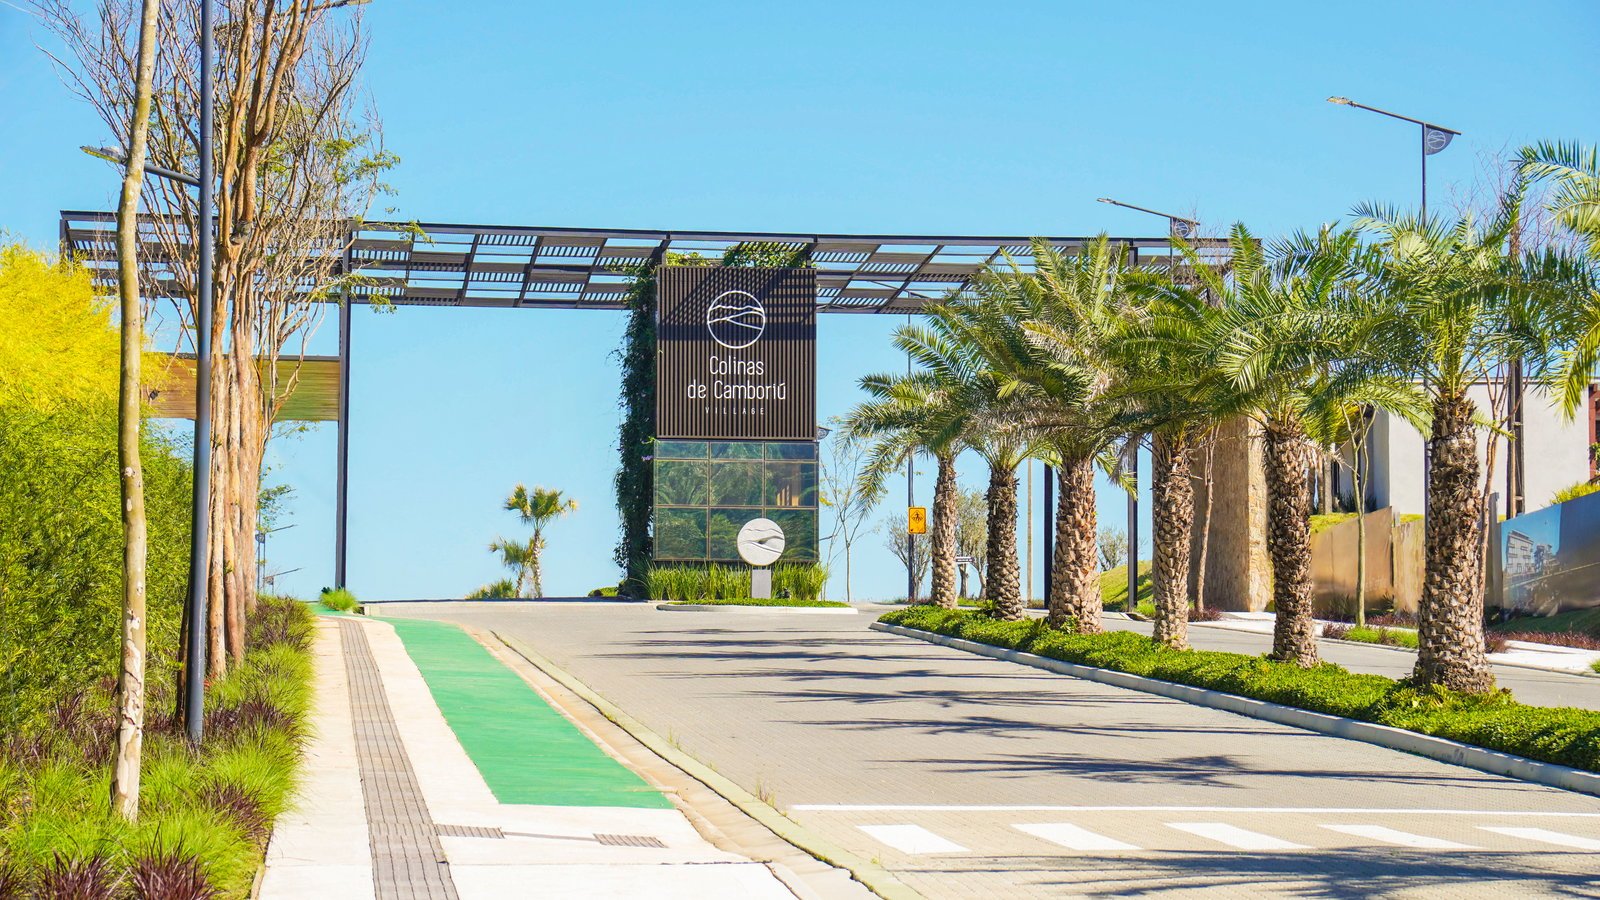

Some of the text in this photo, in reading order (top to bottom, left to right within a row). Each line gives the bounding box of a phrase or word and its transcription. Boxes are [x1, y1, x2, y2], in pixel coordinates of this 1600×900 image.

[709, 355, 764, 375] Colinas
[687, 379, 786, 400] de Camboriú
[705, 407, 764, 415] VILLAGE
